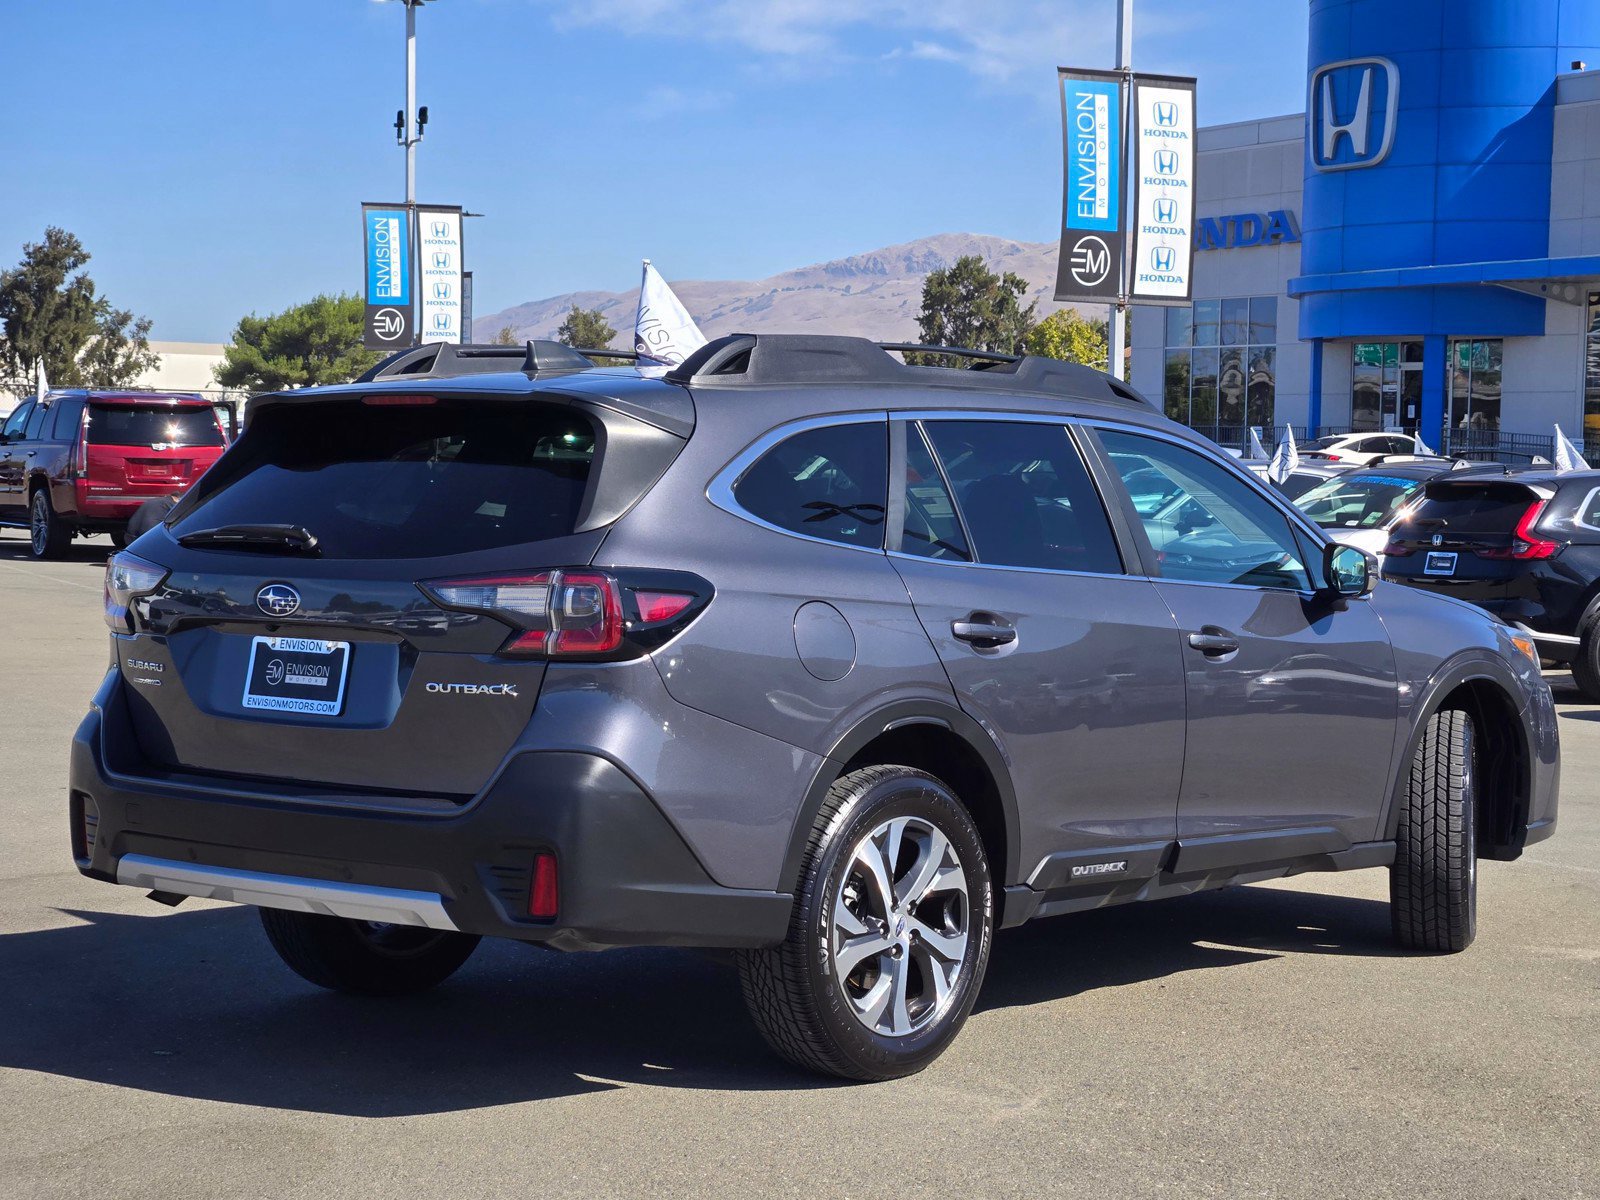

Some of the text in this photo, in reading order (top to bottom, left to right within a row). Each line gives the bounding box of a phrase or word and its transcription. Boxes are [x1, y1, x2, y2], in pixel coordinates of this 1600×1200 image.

[1143, 129, 1188, 140] HONDA
[1075, 92, 1095, 218] ENVISION
[1098, 106, 1106, 208] MOTORS
[1143, 176, 1188, 188] HONDA
[1142, 225, 1187, 236] HONDA
[1194, 210, 1300, 251] NDA
[374, 217, 390, 297] ENVISION
[1139, 273, 1184, 284] HONDA
[280, 639, 323, 651] ENVISION
[127, 659, 164, 672] SUBARU
[286, 663, 331, 677] ENVISION
[288, 677, 325, 685] MOTORS
[425, 682, 518, 696] OUTBACK
[246, 697, 336, 713] ENVISIONMOTORS.COM
[1072, 861, 1127, 876] OUTBACK
